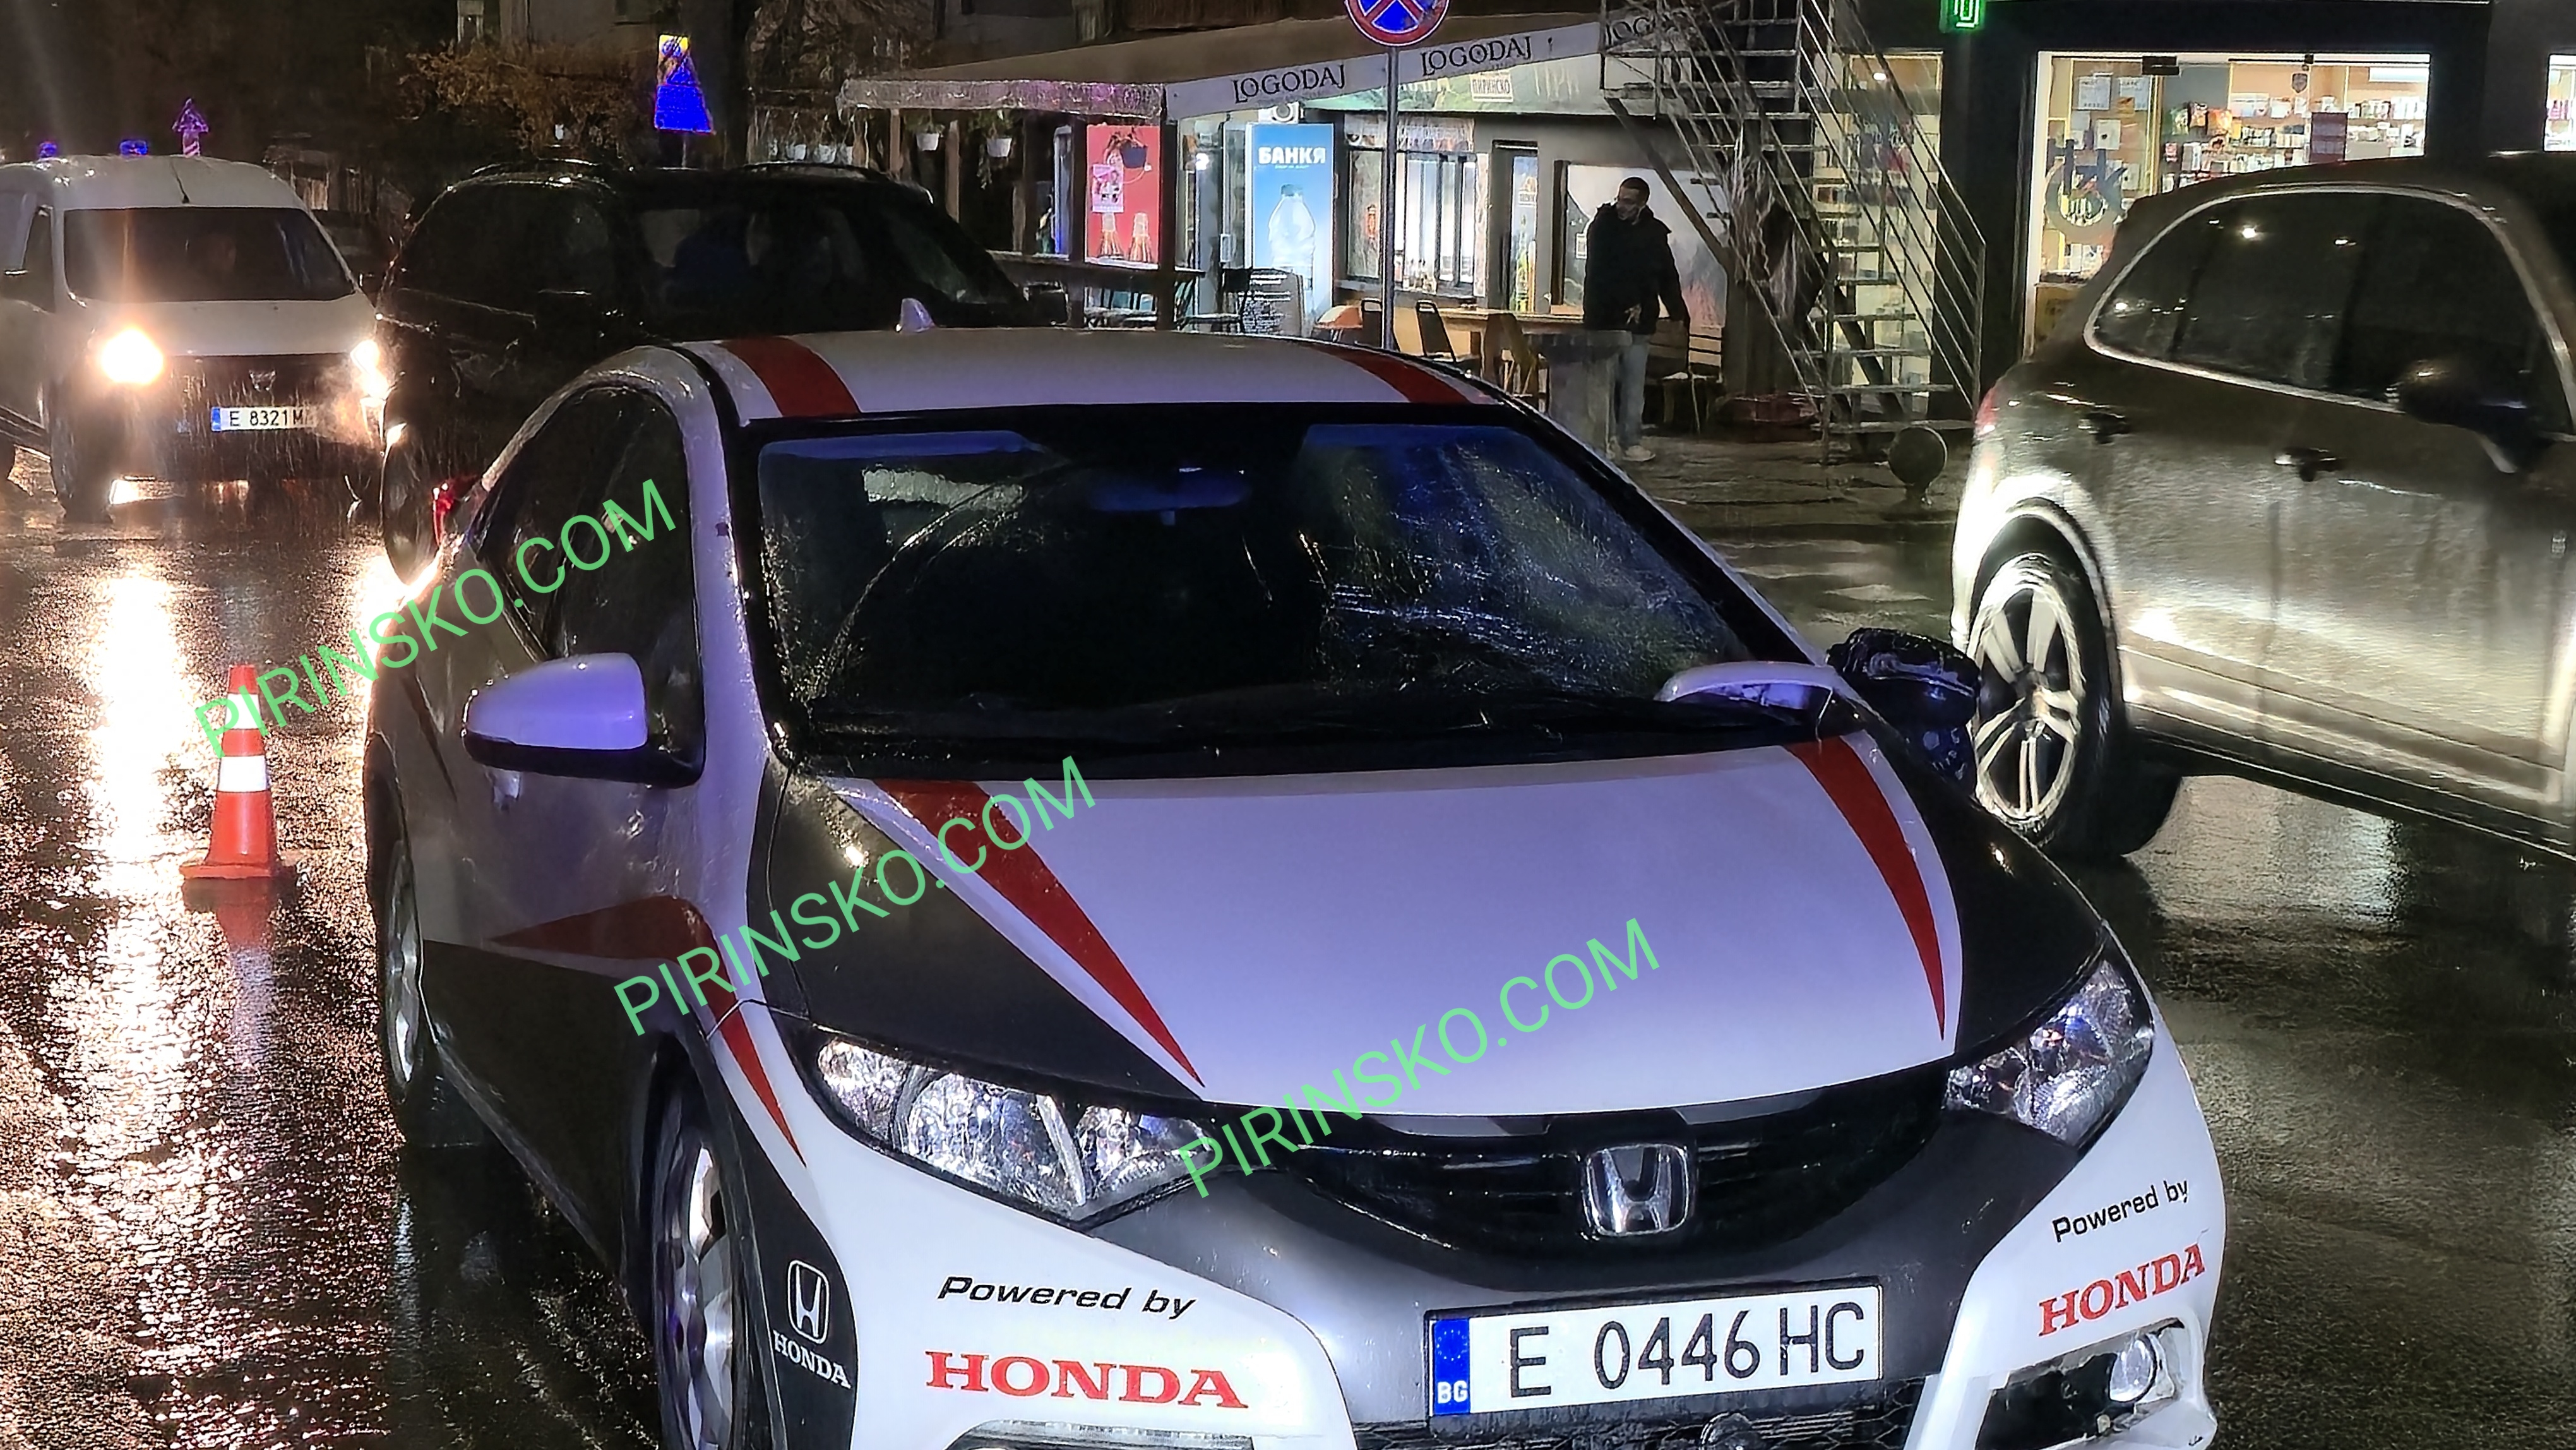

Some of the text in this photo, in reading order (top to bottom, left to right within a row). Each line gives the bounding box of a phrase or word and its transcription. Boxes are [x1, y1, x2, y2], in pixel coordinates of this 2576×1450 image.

[1421, 36, 1532, 76] LOGODAJ
[1233, 64, 1345, 104] LOGODAJ
[1258, 147, 1326, 164] БАНКЯ
[230, 411, 241, 426] E
[250, 410, 287, 426] 8321
[2052, 1180, 2188, 1243] Powered by
[938, 1276, 1195, 1319] Powered by
[2039, 1243, 2205, 1337] HONDA
[773, 1329, 852, 1389] HONDA
[1510, 1326, 1551, 1398] E
[1594, 1309, 1761, 1390] 0446
[926, 1350, 1249, 1409] HONDA
[1437, 1381, 1468, 1404] BG
